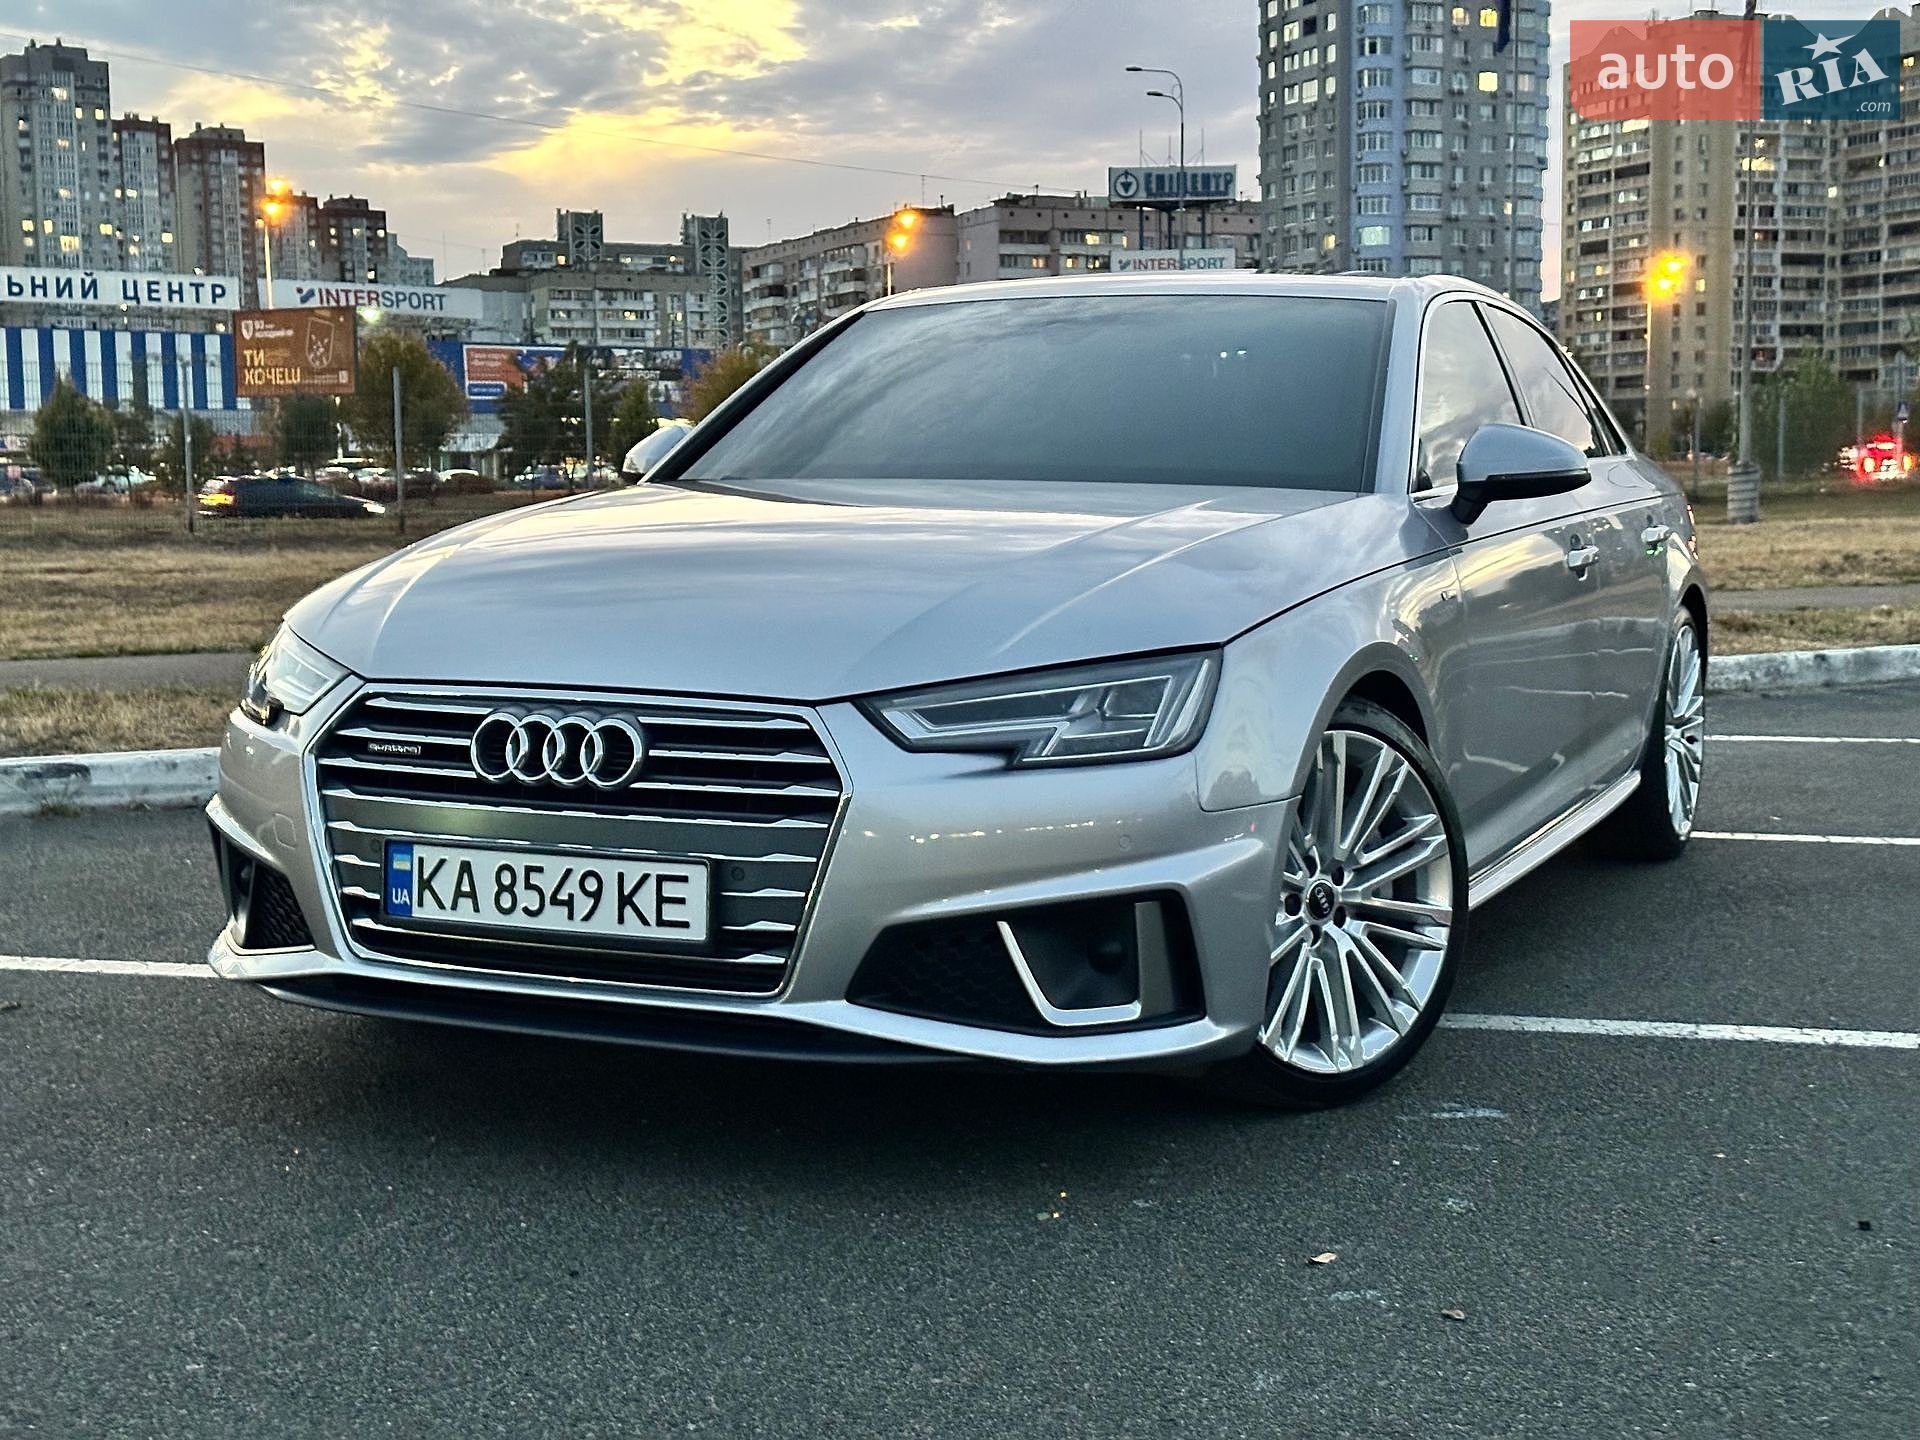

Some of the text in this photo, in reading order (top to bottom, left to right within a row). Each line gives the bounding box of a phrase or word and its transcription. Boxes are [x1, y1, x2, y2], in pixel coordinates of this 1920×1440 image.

[6, 270, 227, 305] ЬНИЙ ЦЕНТР
[318, 287, 447, 312] INTERSPORT
[243, 348, 265, 367] ТИ
[392, 887, 410, 905] UA
[416, 856, 691, 929] KA 8549 KE
